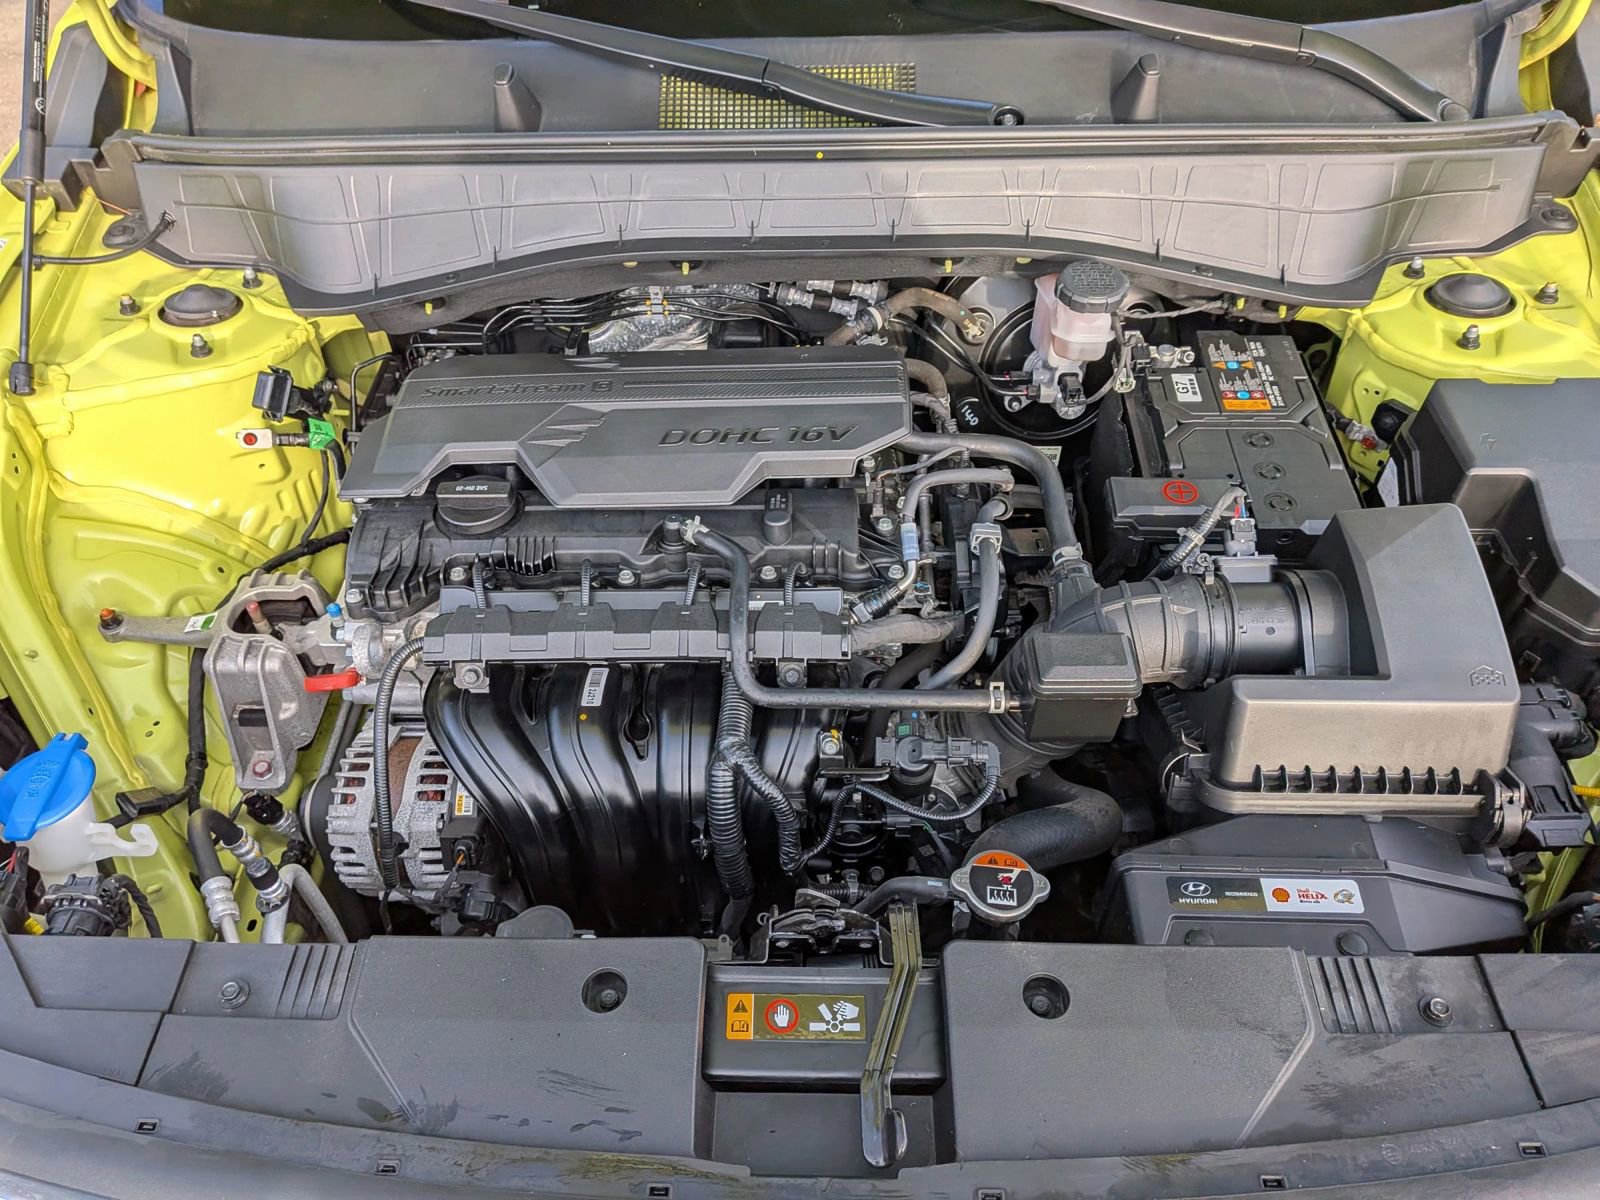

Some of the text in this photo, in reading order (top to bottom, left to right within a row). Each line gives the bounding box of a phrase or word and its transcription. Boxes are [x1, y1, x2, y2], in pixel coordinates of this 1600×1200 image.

[421, 381, 587, 399] Smartstream
[1175, 380, 1190, 394] G7
[961, 404, 979, 426] 140
[658, 424, 860, 447] DOHC 16V
[1178, 897, 1218, 905] HYUNDAI
